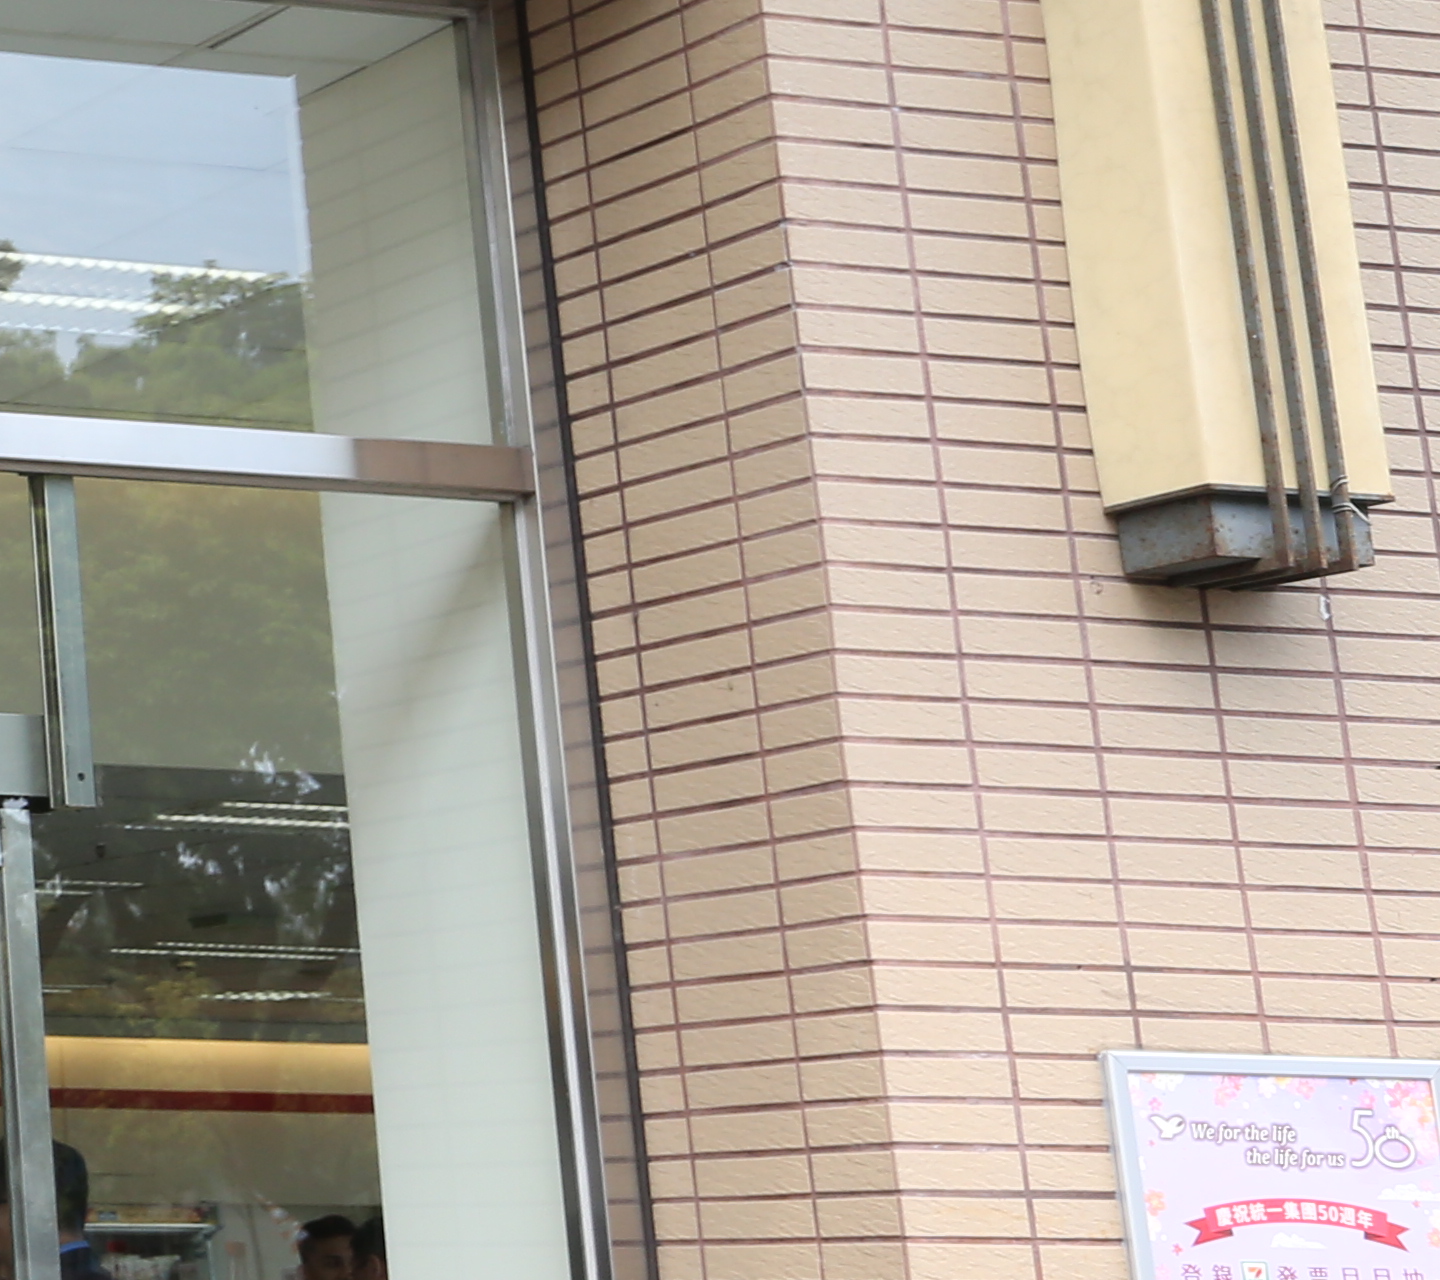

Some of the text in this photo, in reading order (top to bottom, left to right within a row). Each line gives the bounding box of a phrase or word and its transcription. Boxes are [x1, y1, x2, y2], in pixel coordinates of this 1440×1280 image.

[1191, 1123, 1297, 1146] We for the life
[1246, 1148, 1345, 1170] the life for us
